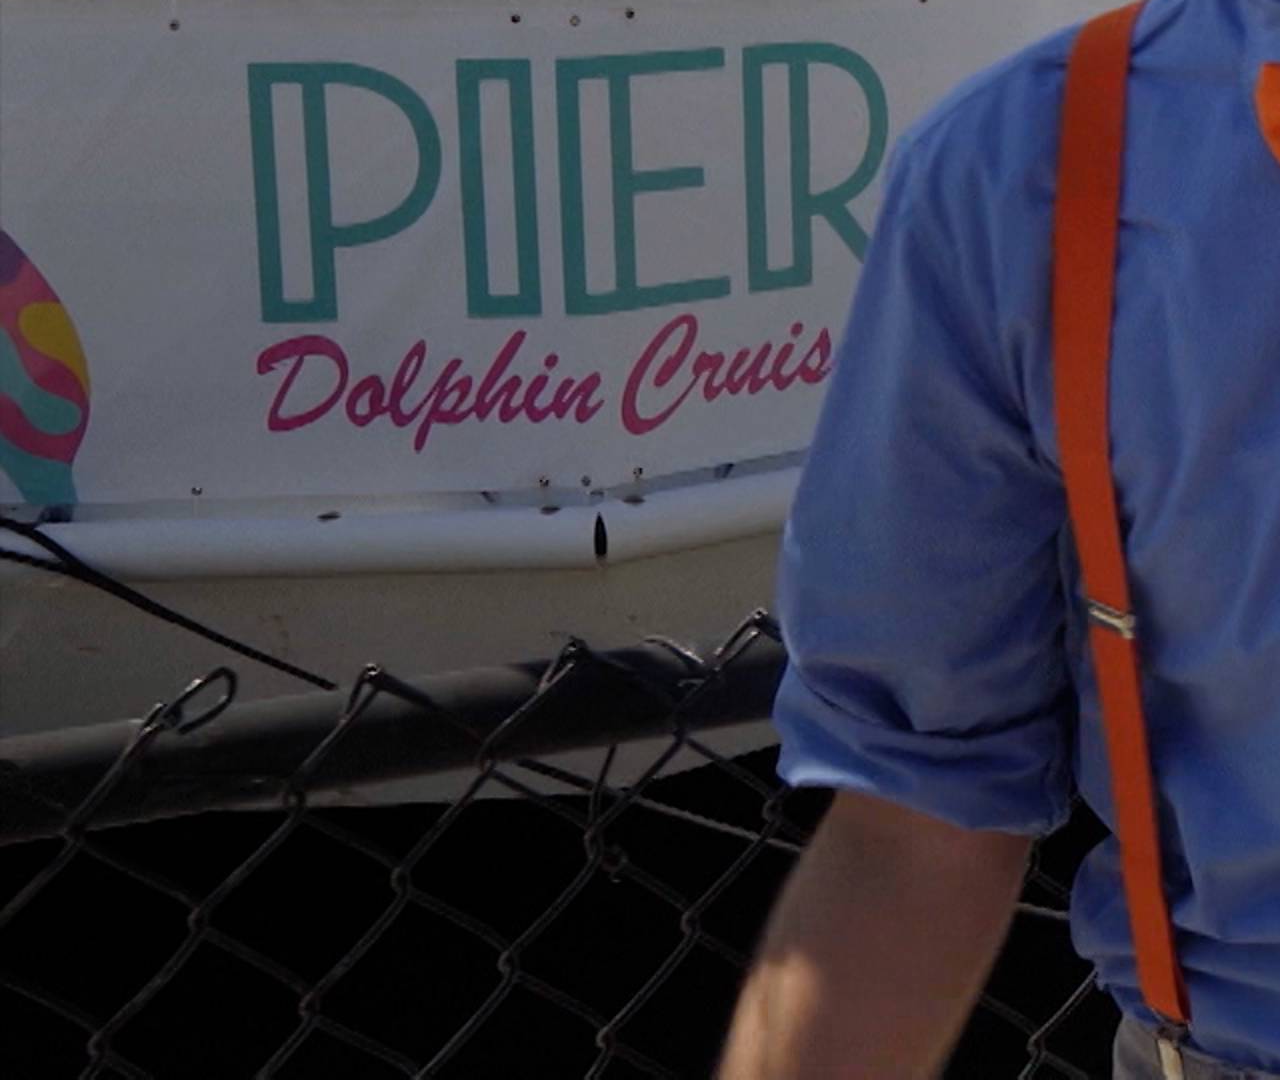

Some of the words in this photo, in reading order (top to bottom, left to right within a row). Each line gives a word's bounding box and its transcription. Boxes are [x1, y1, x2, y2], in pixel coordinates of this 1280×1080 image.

[247, 42, 889, 323] PIER
[256, 331, 604, 453] Dolphin
[621, 314, 832, 435] Cruis
